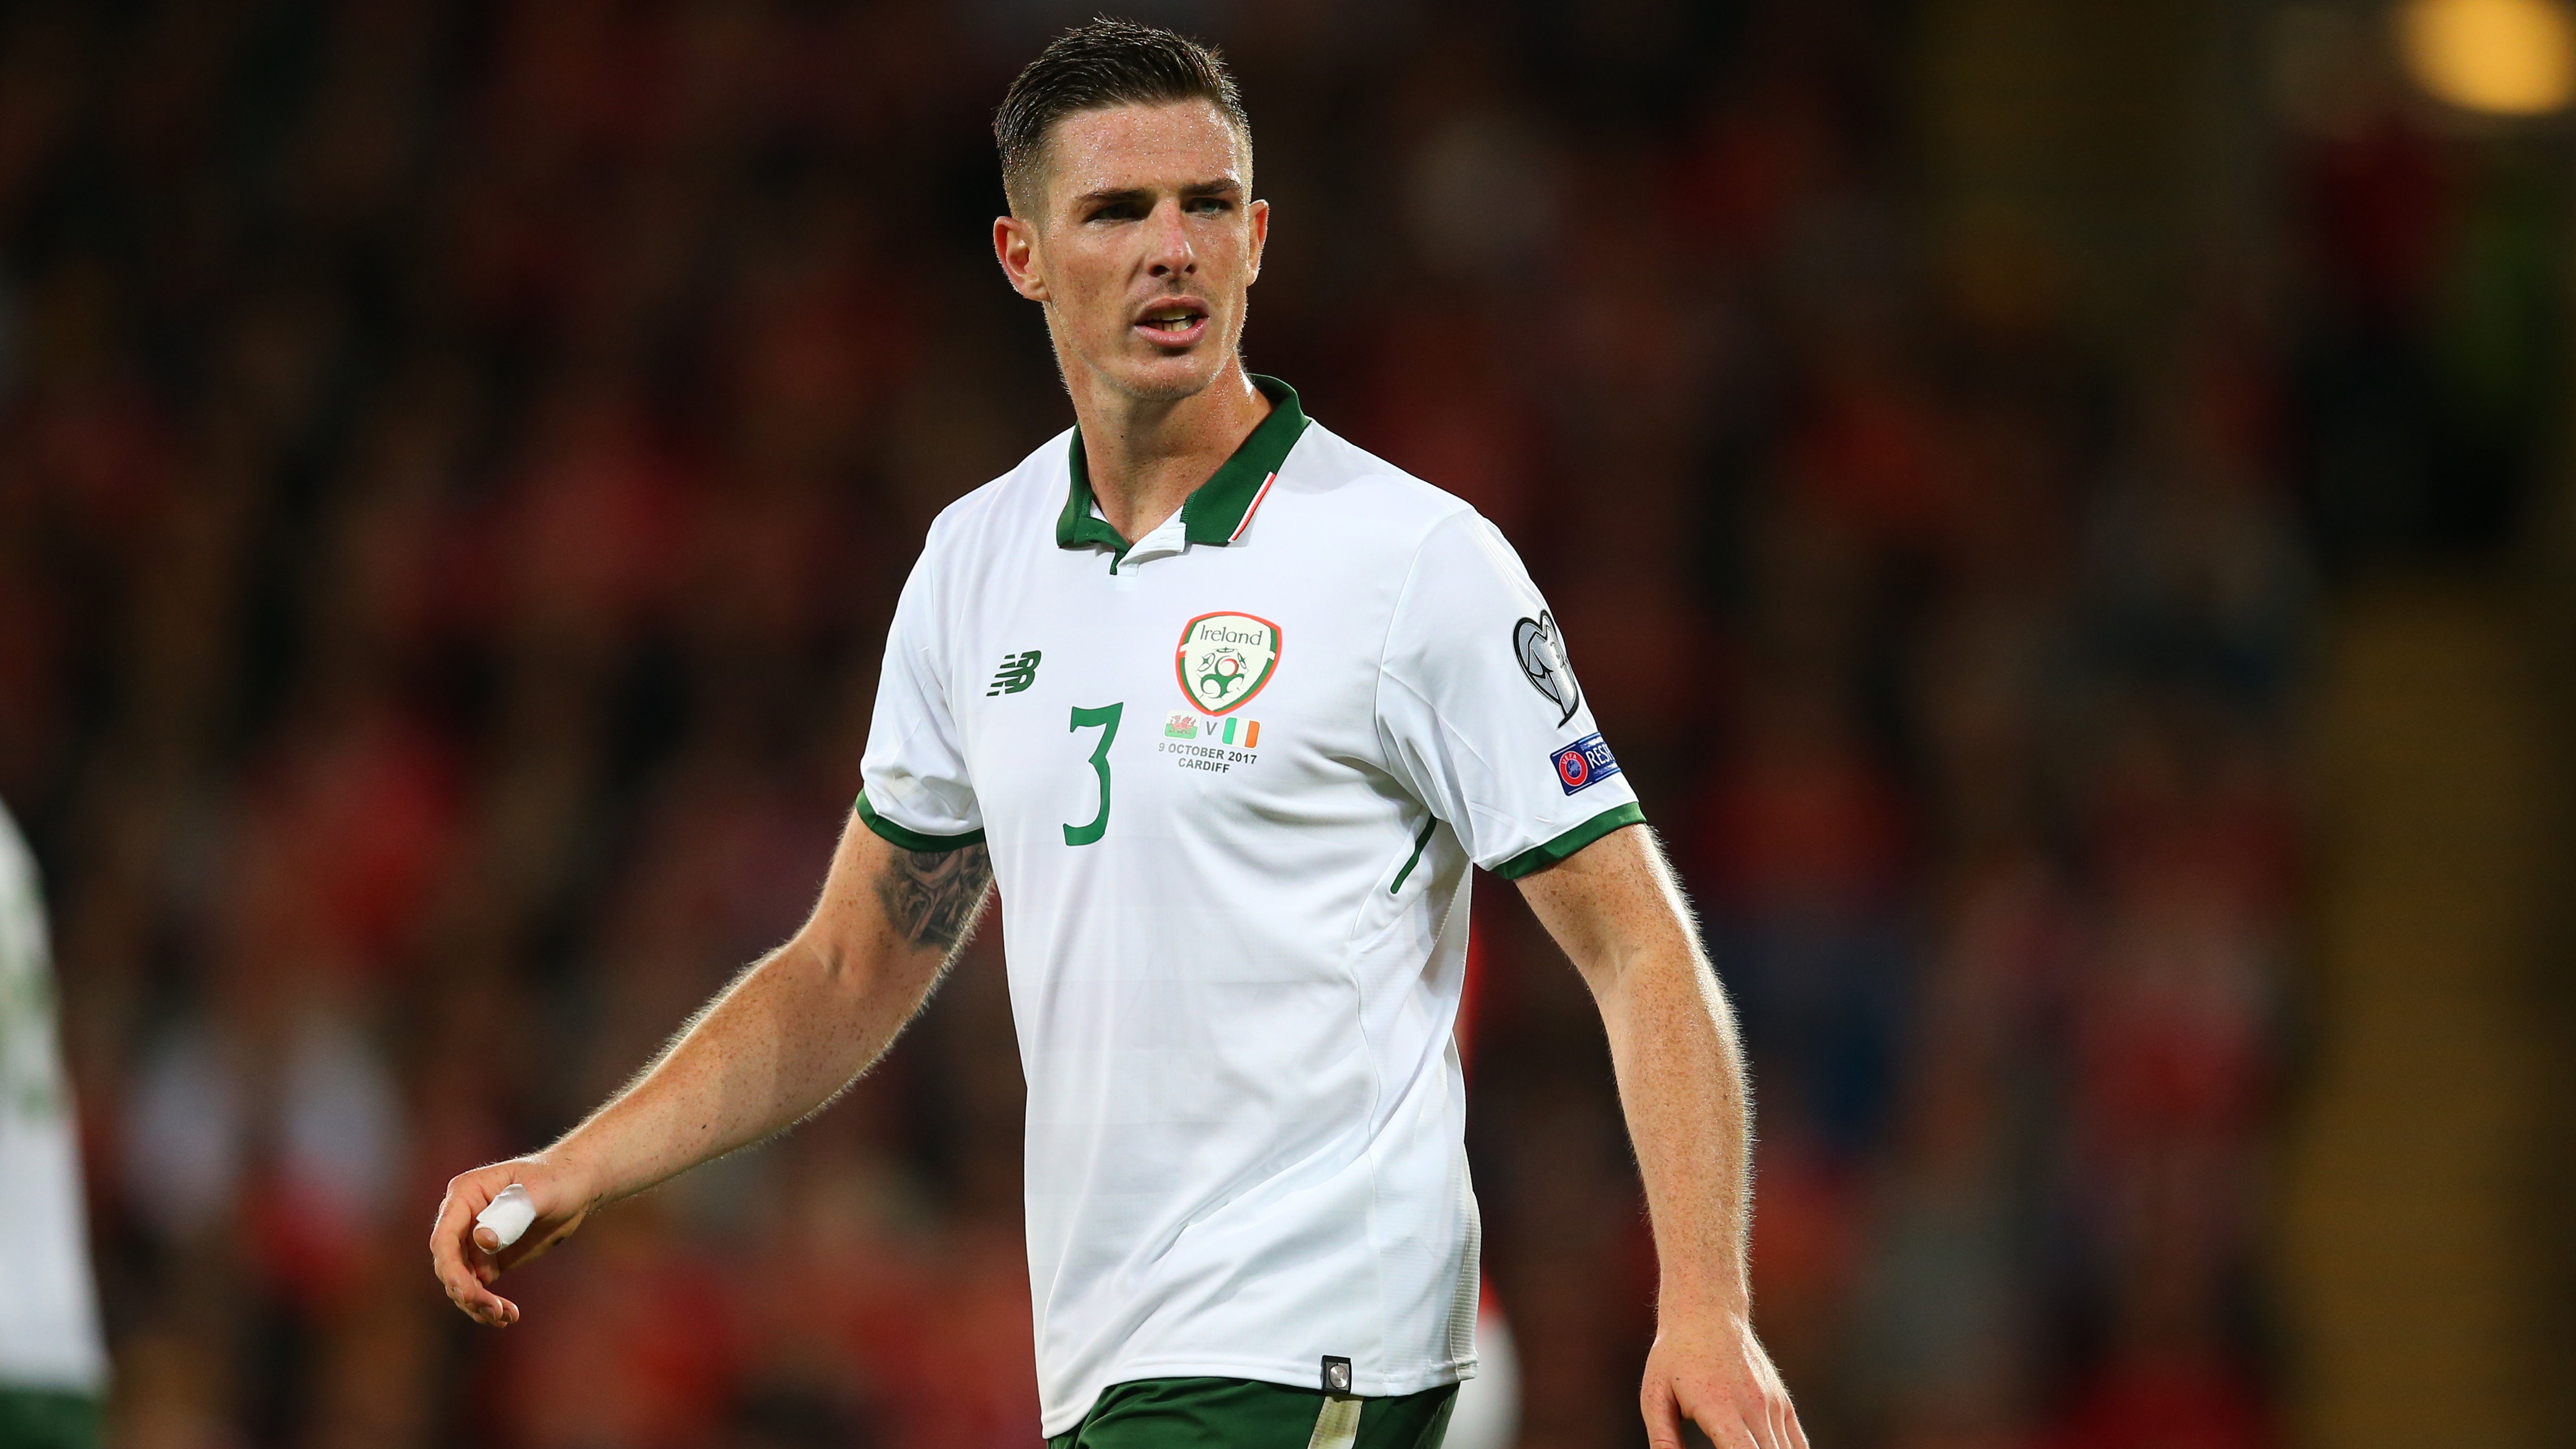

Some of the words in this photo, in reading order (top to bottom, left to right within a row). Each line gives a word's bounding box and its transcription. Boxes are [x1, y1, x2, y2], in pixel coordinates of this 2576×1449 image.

[1200, 625, 1263, 646] Ireland
[1158, 742, 1165, 752] 9
[1168, 743, 1225, 759] OCTOBER
[1228, 751, 1257, 764] 2017
[1562, 753, 1577, 764] UEFA
[1063, 702, 1123, 846] 3
[1178, 758, 1230, 773] CARDIFF
